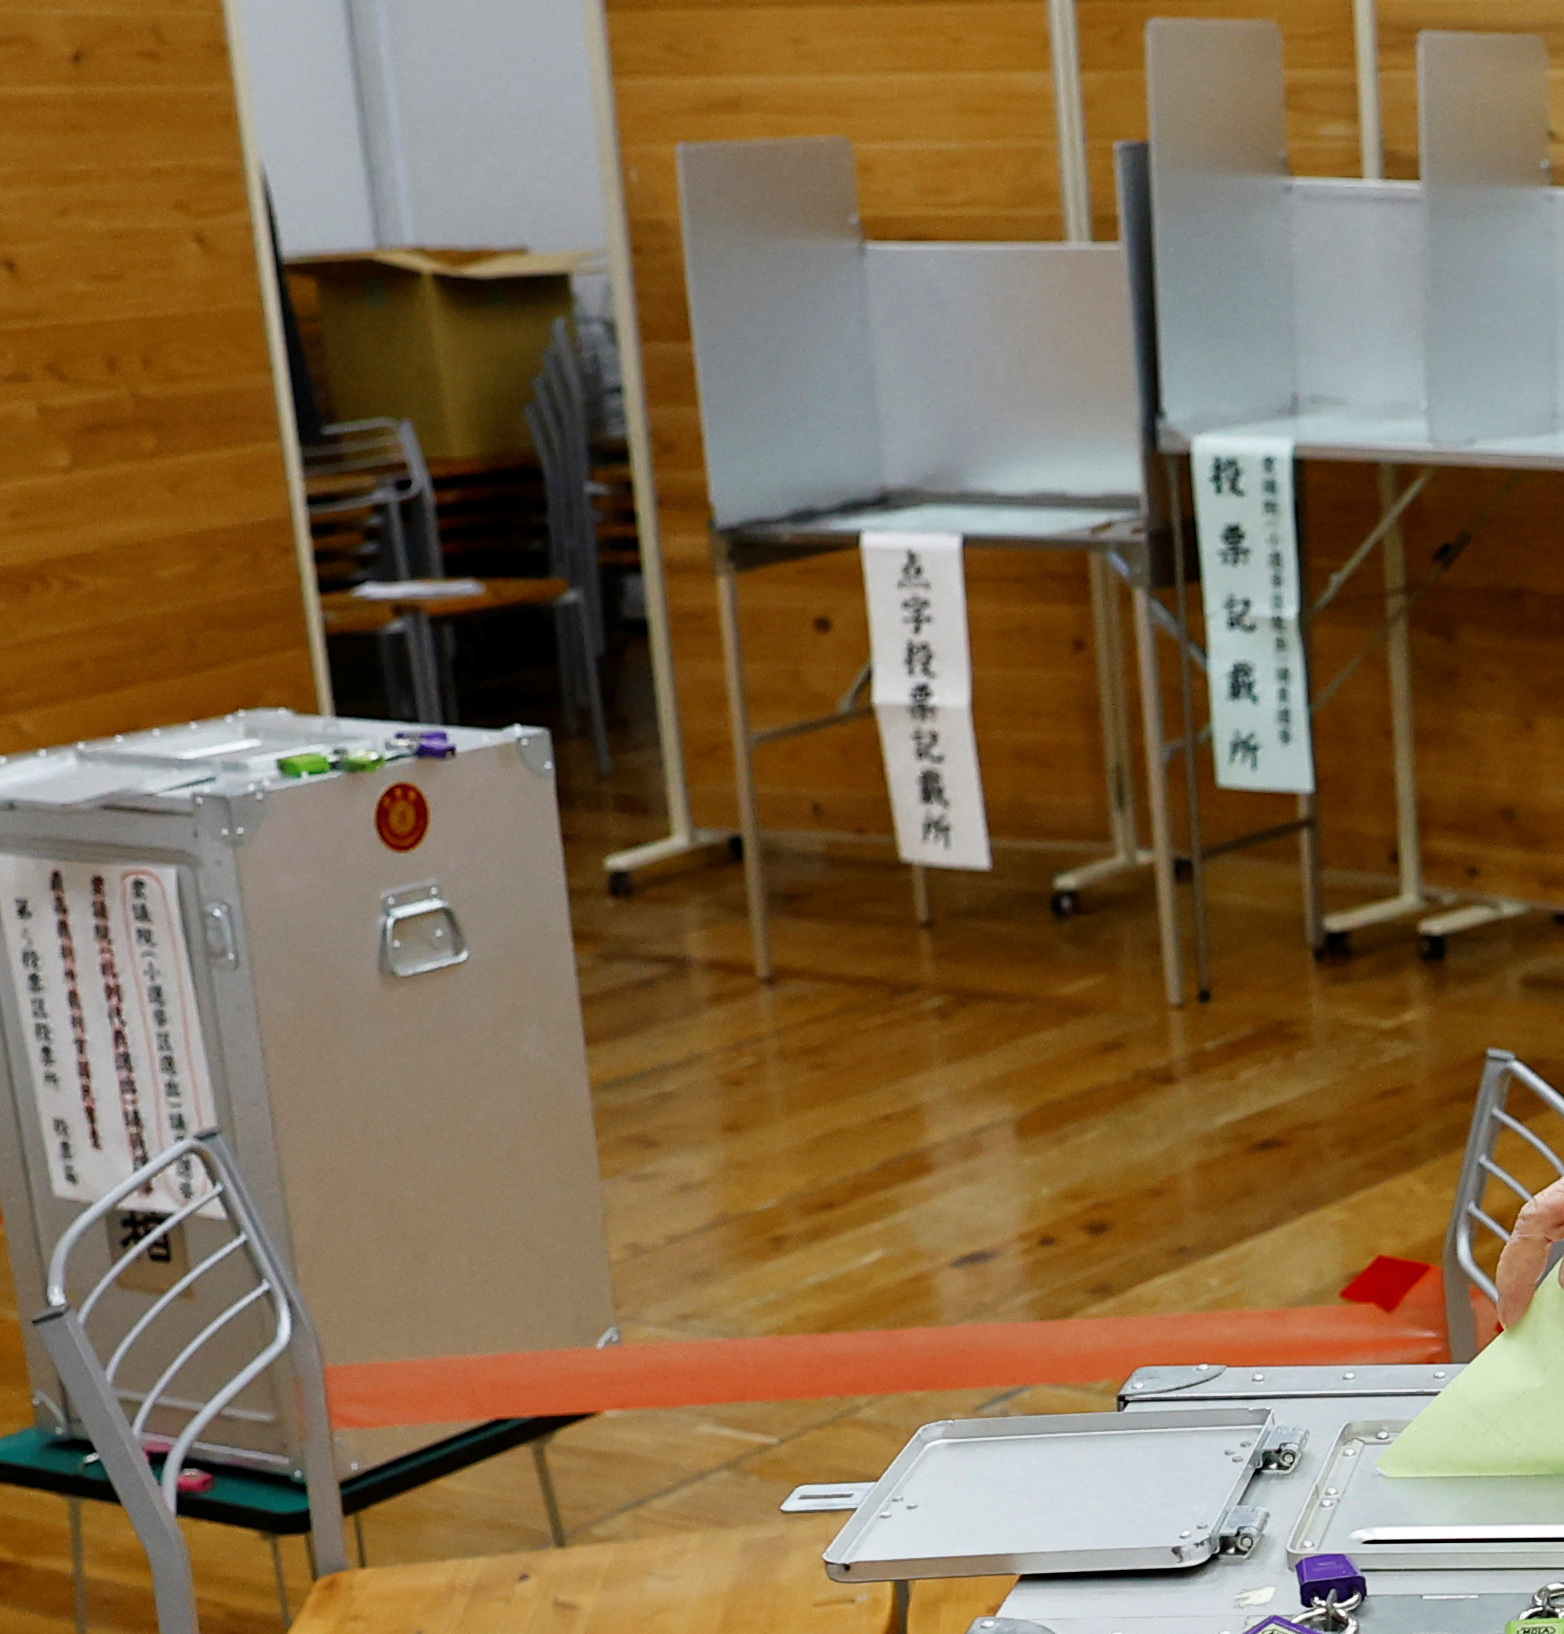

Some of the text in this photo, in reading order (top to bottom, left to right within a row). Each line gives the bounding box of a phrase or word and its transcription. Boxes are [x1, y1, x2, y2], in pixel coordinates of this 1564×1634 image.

[896, 548, 953, 851] 点字投票記載所
[1208, 456, 1261, 771] 投票記載所
